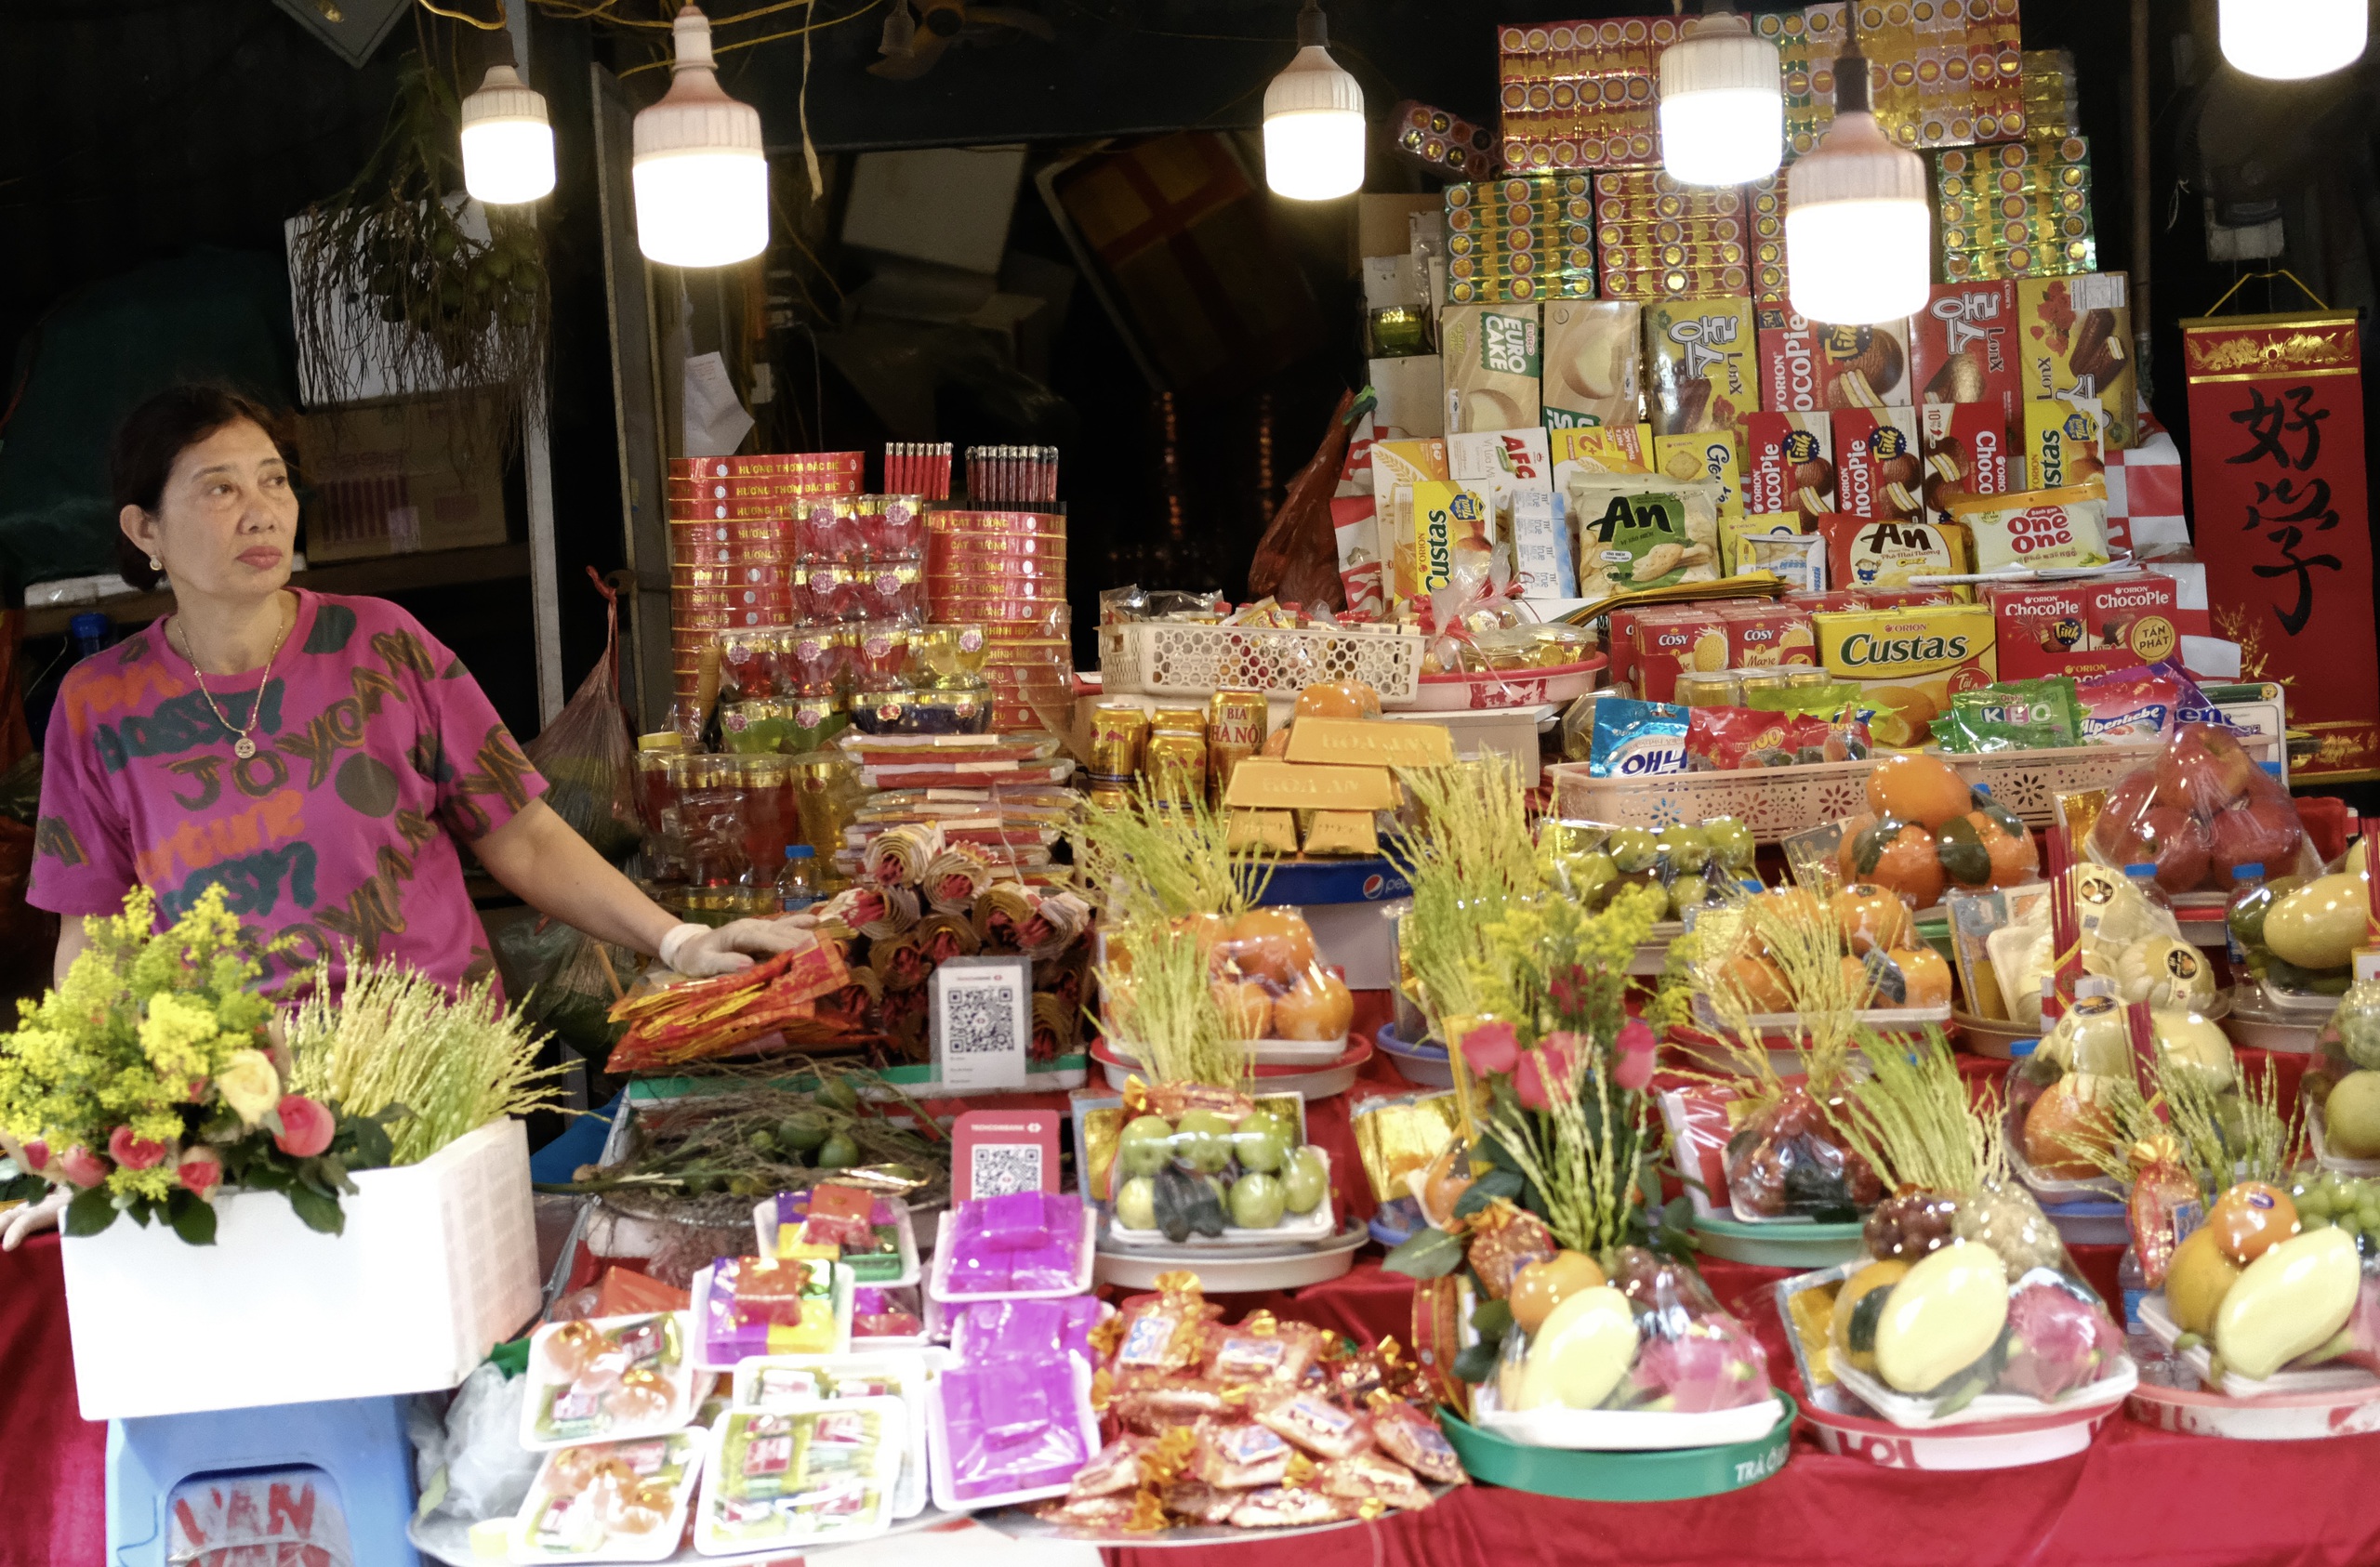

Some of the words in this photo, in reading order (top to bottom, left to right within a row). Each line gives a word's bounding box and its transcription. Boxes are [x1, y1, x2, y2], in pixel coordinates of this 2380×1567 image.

[1486, 315, 1508, 371] CAKE
[1503, 317, 1527, 374] EURO
[1526, 323, 1535, 356] EURO
[1988, 327, 2003, 372] LonX
[1726, 352, 1743, 395] LonX
[1774, 354, 1788, 401] ORION
[1783, 313, 1814, 411] ocoPie
[2036, 356, 2053, 401] LonX
[776, 462, 804, 473] THƠM
[826, 461, 840, 471] BIỆ
[1500, 435, 1537, 480] AFC
[2031, 454, 2041, 484] ORION
[2040, 429, 2062, 489] stas
[774, 481, 801, 494] THƠM
[1752, 470, 1763, 503] ORION
[1760, 443, 1781, 513] ocoPie
[1841, 467, 1852, 499] ORION
[1847, 439, 1871, 518] hocoPie
[1996, 467, 2006, 493] ORIO
[1586, 495, 1674, 543] An
[2007, 514, 2069, 535] One
[1418, 533, 1427, 562] ORION
[1424, 509, 1451, 593] Custas
[1859, 523, 1933, 554] An
[2011, 530, 2073, 554] One
[2004, 602, 2080, 616] ChocoPie
[2095, 592, 2170, 610] ChocoPie
[1658, 633, 1689, 647] COSY
[1743, 628, 1775, 642] COSY
[1894, 624, 1927, 633] ORION
[2139, 634, 2170, 651] PHÁT
[2142, 623, 2166, 639] TẤN
[1840, 632, 1969, 666] Custas
[2075, 664, 2107, 673] ORION
[1226, 707, 1248, 720] BIA
[2081, 706, 2160, 737] Alpenliebe
[1210, 722, 1233, 744] HÀ
[1234, 723, 1263, 749] NỘI
[1748, 728, 1782, 751] 100
[1385, 877, 1408, 894] pep
[1735, 1453, 1765, 1484] TRÀ
